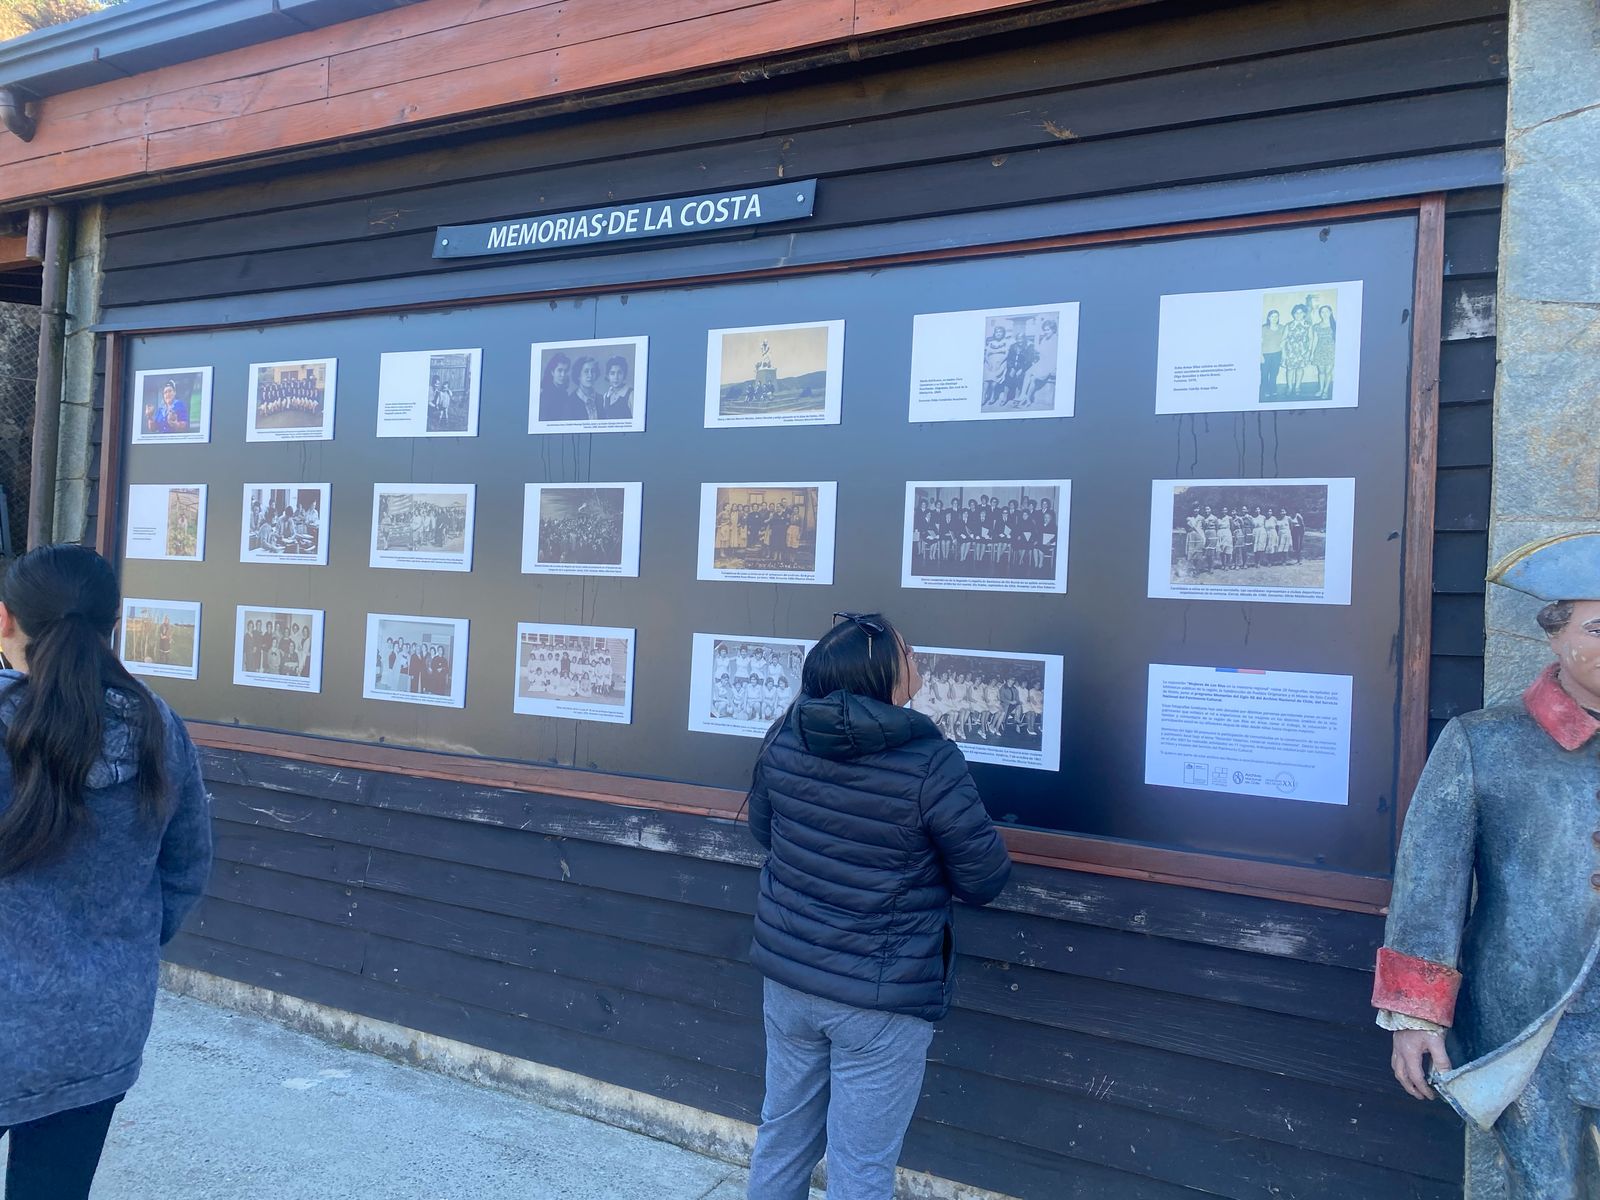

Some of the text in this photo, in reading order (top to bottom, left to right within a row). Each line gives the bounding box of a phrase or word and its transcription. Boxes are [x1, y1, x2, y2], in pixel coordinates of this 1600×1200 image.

[487, 194, 761, 249] MEMORIAS DE LA COSTA
